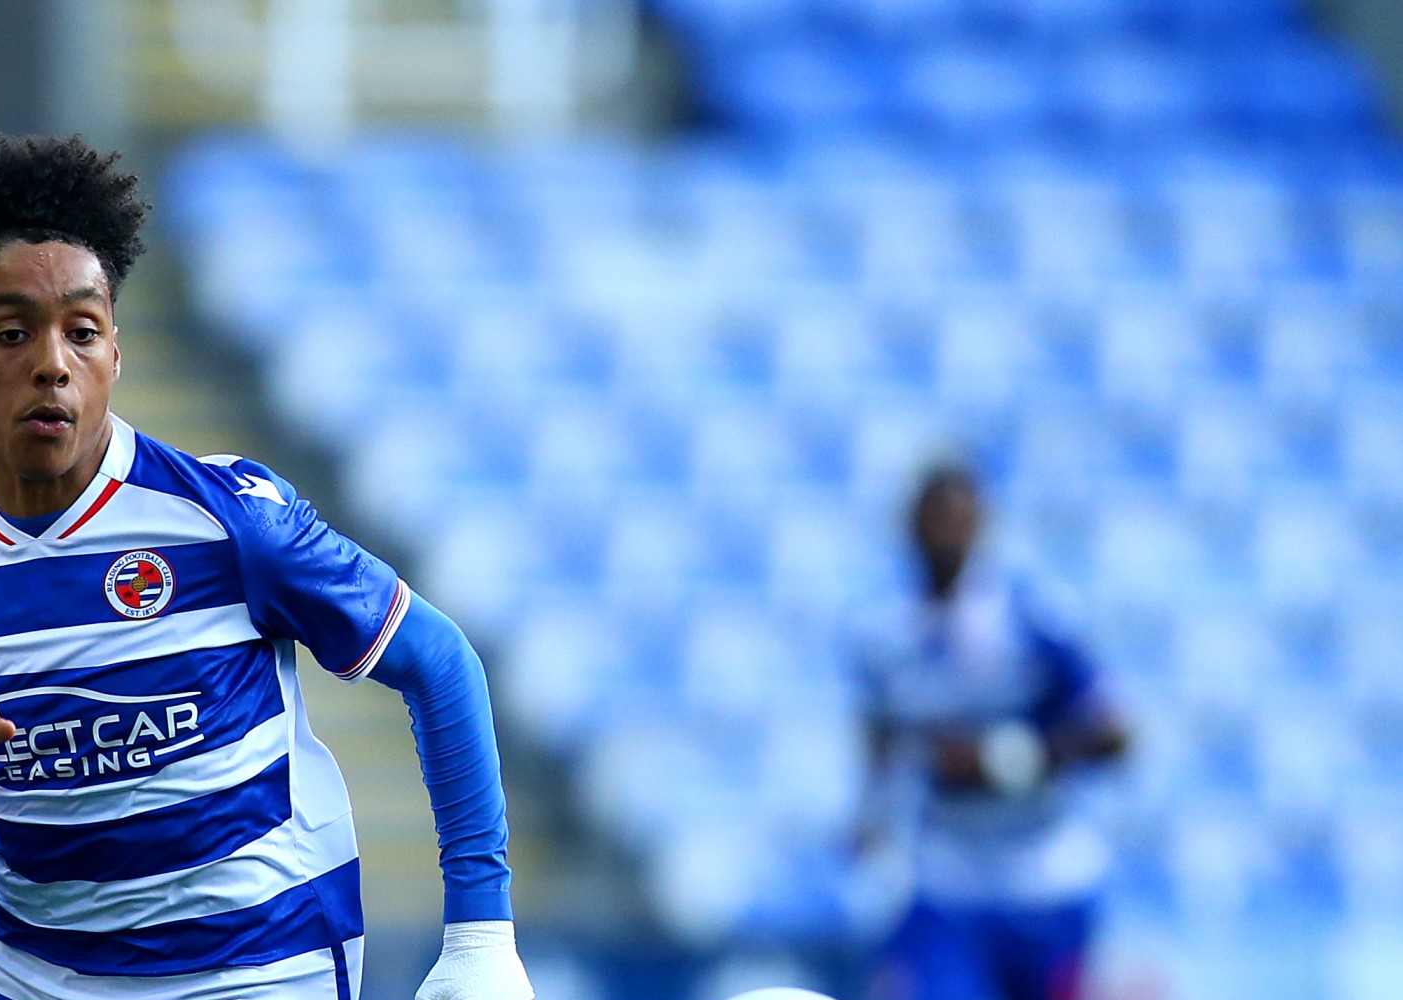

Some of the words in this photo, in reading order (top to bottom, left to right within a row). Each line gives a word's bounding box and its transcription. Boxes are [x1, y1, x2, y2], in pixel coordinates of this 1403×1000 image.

[106, 559, 124, 592] READING
[124, 552, 162, 567] FOOTBALL
[161, 566, 172, 587] CLUB
[92, 702, 199, 749] CAR
